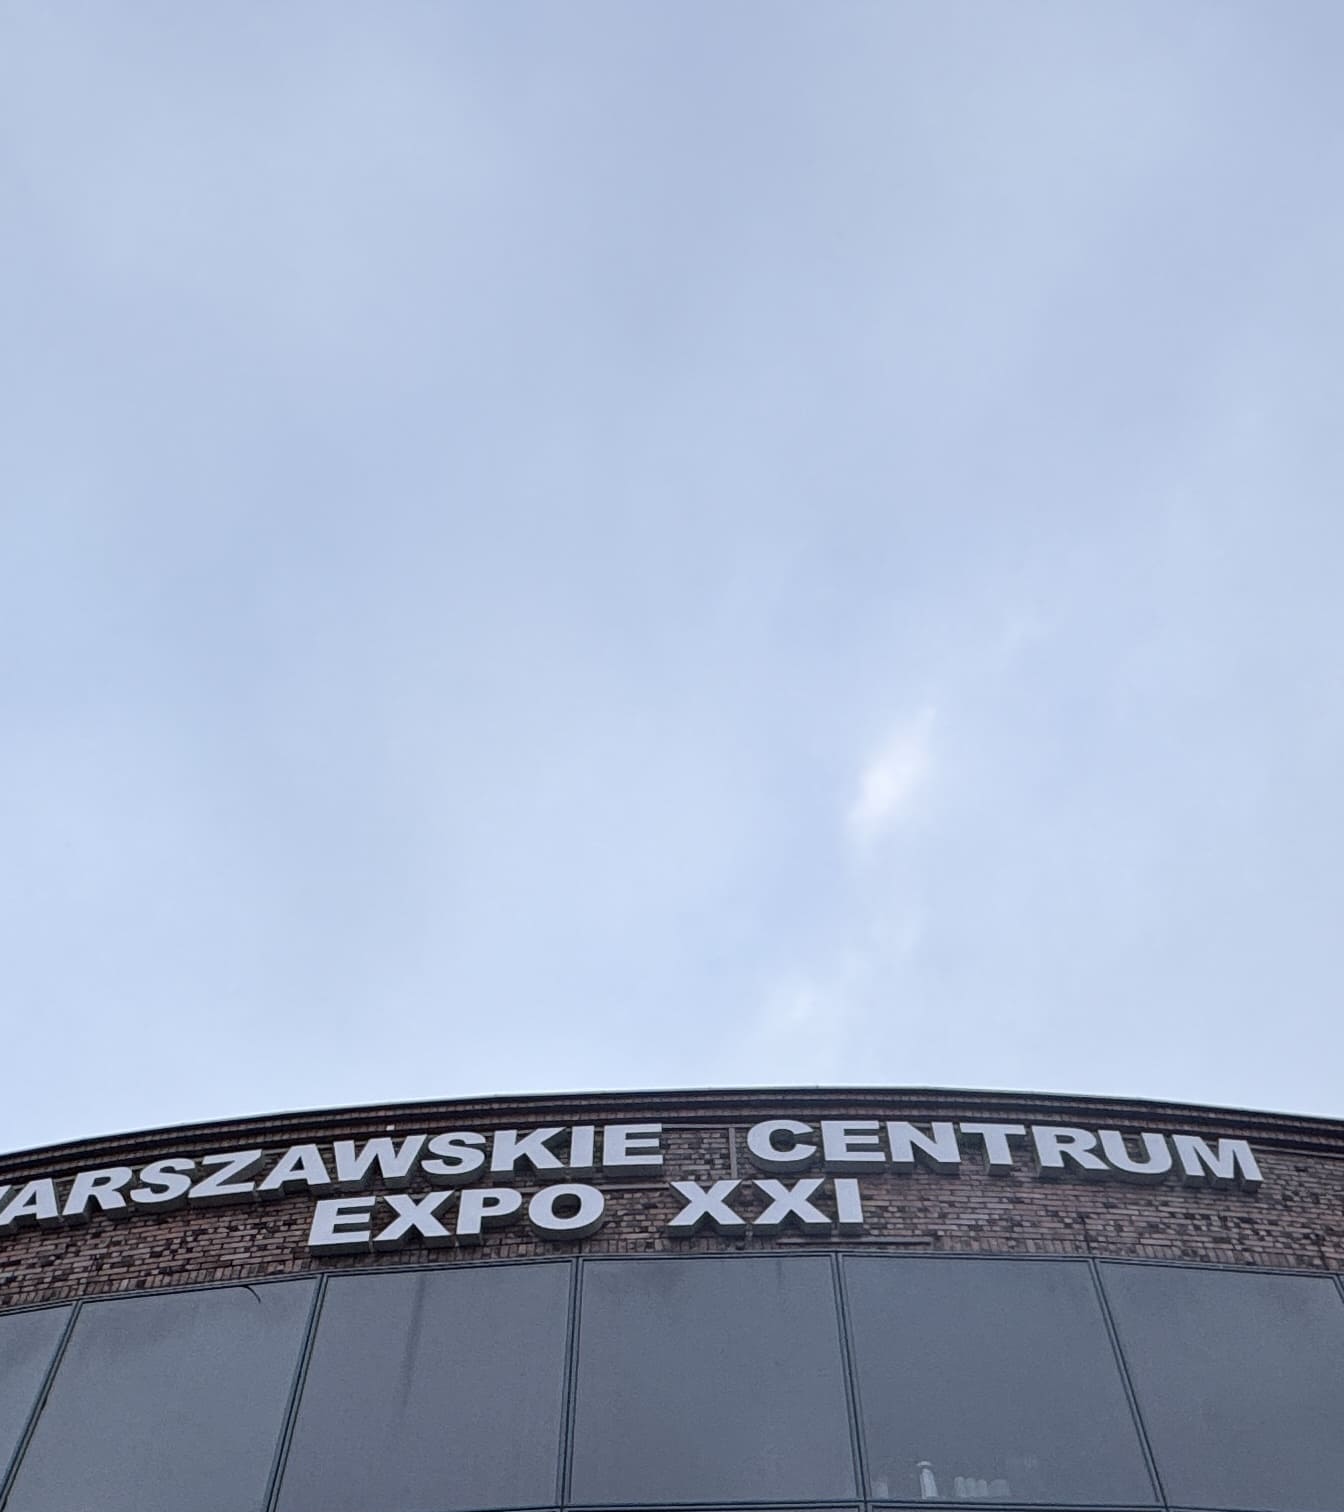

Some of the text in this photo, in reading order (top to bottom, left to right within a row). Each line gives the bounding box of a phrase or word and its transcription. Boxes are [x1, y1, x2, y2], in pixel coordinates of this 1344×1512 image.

[744, 1118, 1262, 1182] CENTRUM
[306, 1175, 864, 1255] EXPO XXI
